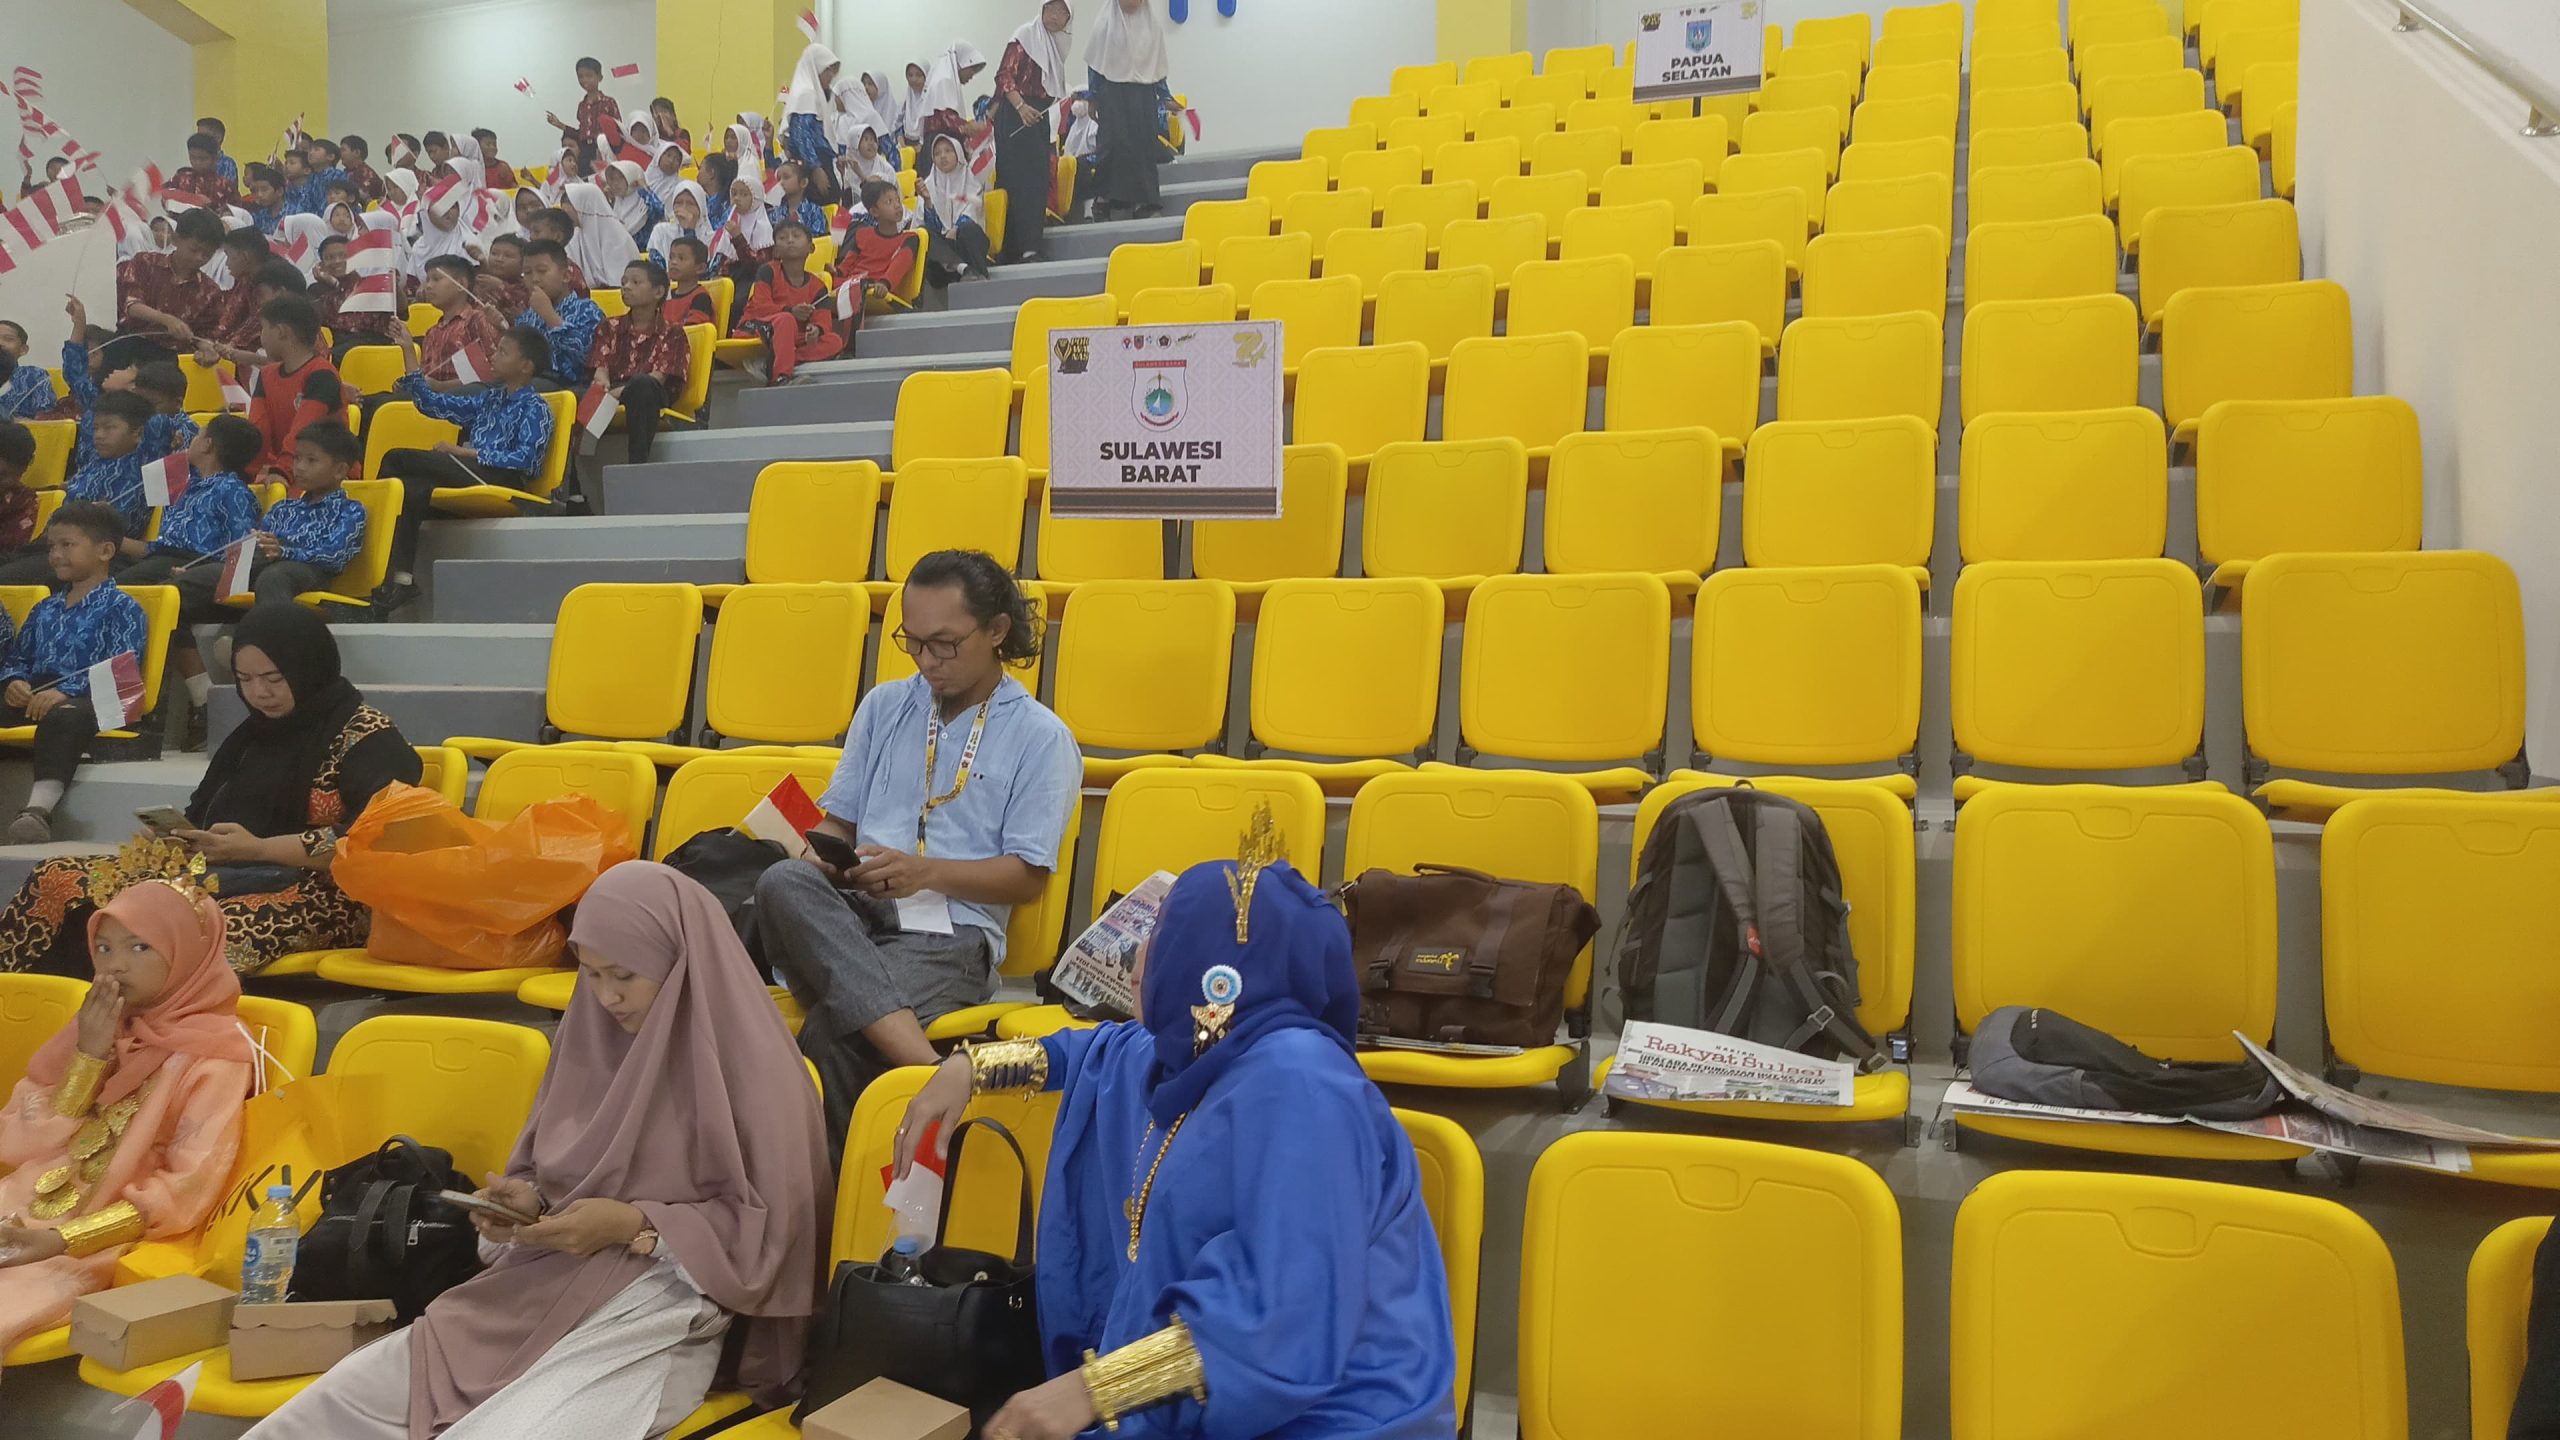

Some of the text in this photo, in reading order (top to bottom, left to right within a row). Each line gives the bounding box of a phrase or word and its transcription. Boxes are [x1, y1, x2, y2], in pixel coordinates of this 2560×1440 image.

[1670, 53, 1724, 69] PAPUA
[1661, 65, 1732, 82] SELATAN
[1100, 441, 1222, 460] SULAWESI
[1121, 465, 1201, 483] BARAT
[1644, 1034, 1738, 1066] Rakyat
[1742, 1056, 1824, 1077] Sulsel
